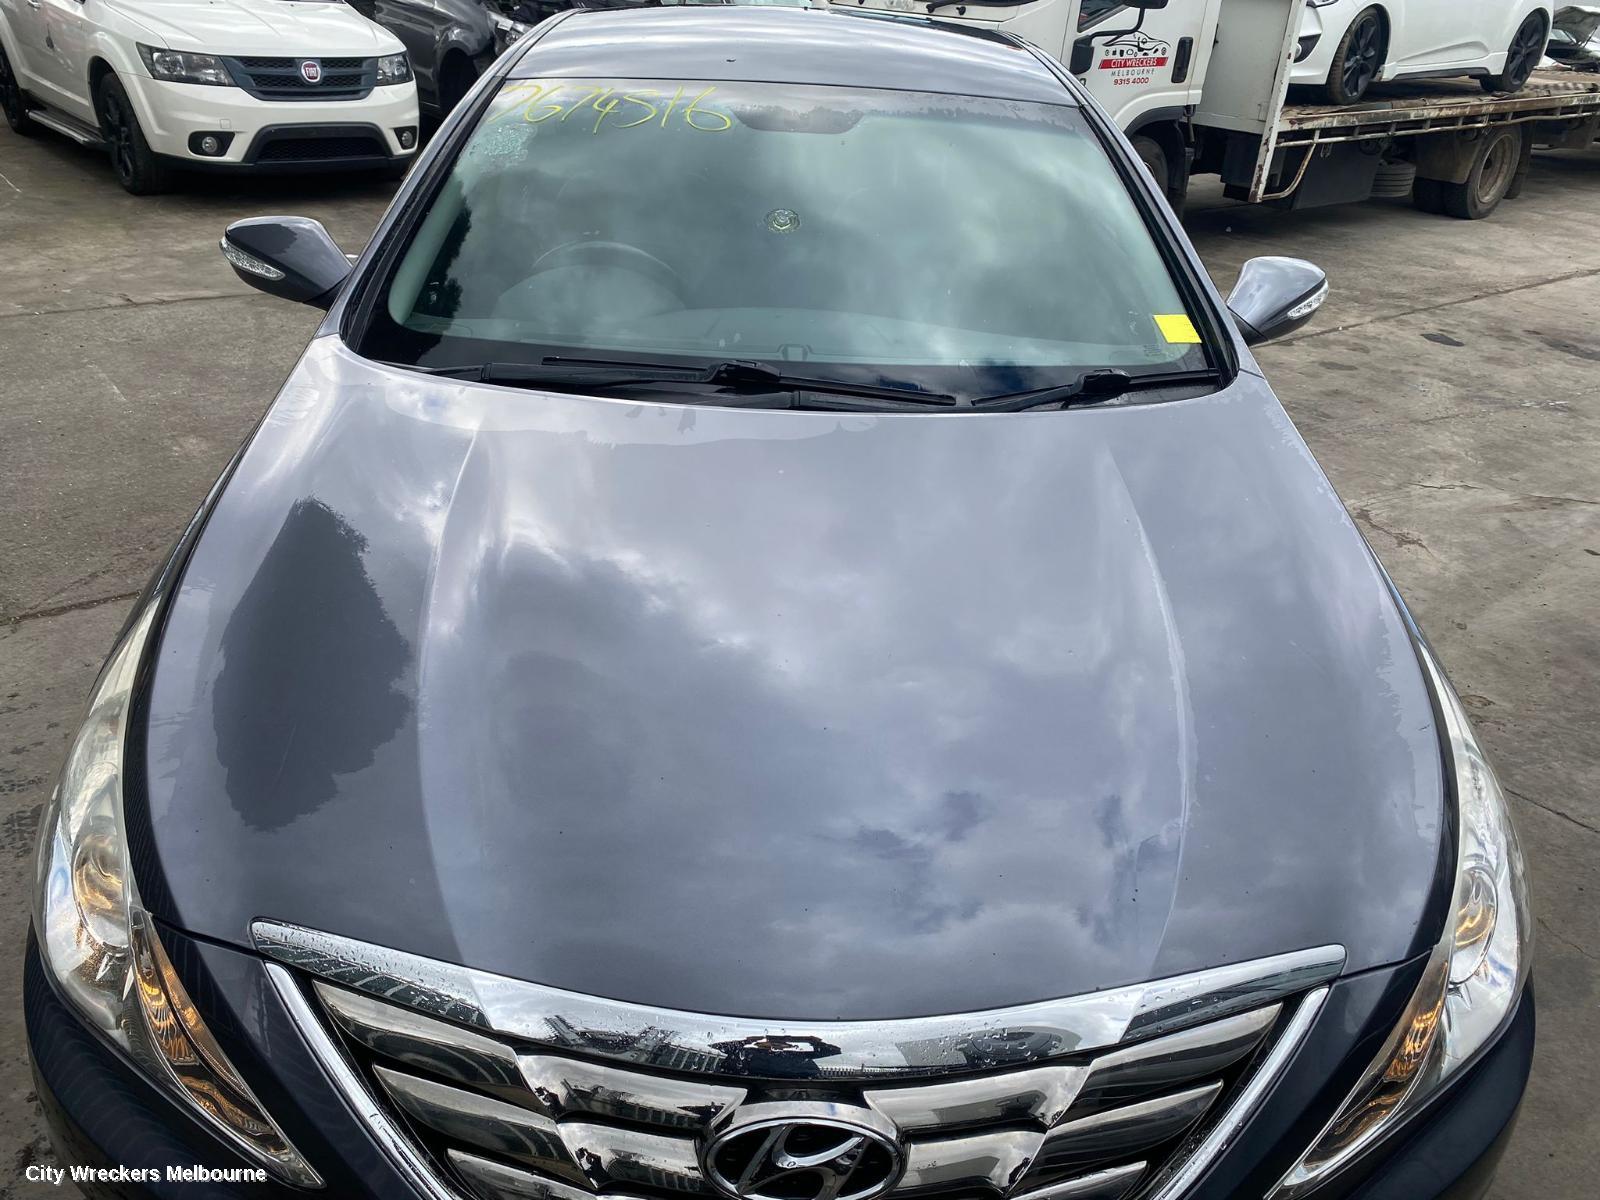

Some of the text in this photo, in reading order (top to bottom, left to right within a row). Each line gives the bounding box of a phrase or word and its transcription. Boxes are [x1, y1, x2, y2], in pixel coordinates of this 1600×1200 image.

[1111, 57, 1157, 68] CITY WRECKERS
[1111, 68, 1154, 77] MELBOURNE
[1113, 77, 1149, 86] 9315 4000
